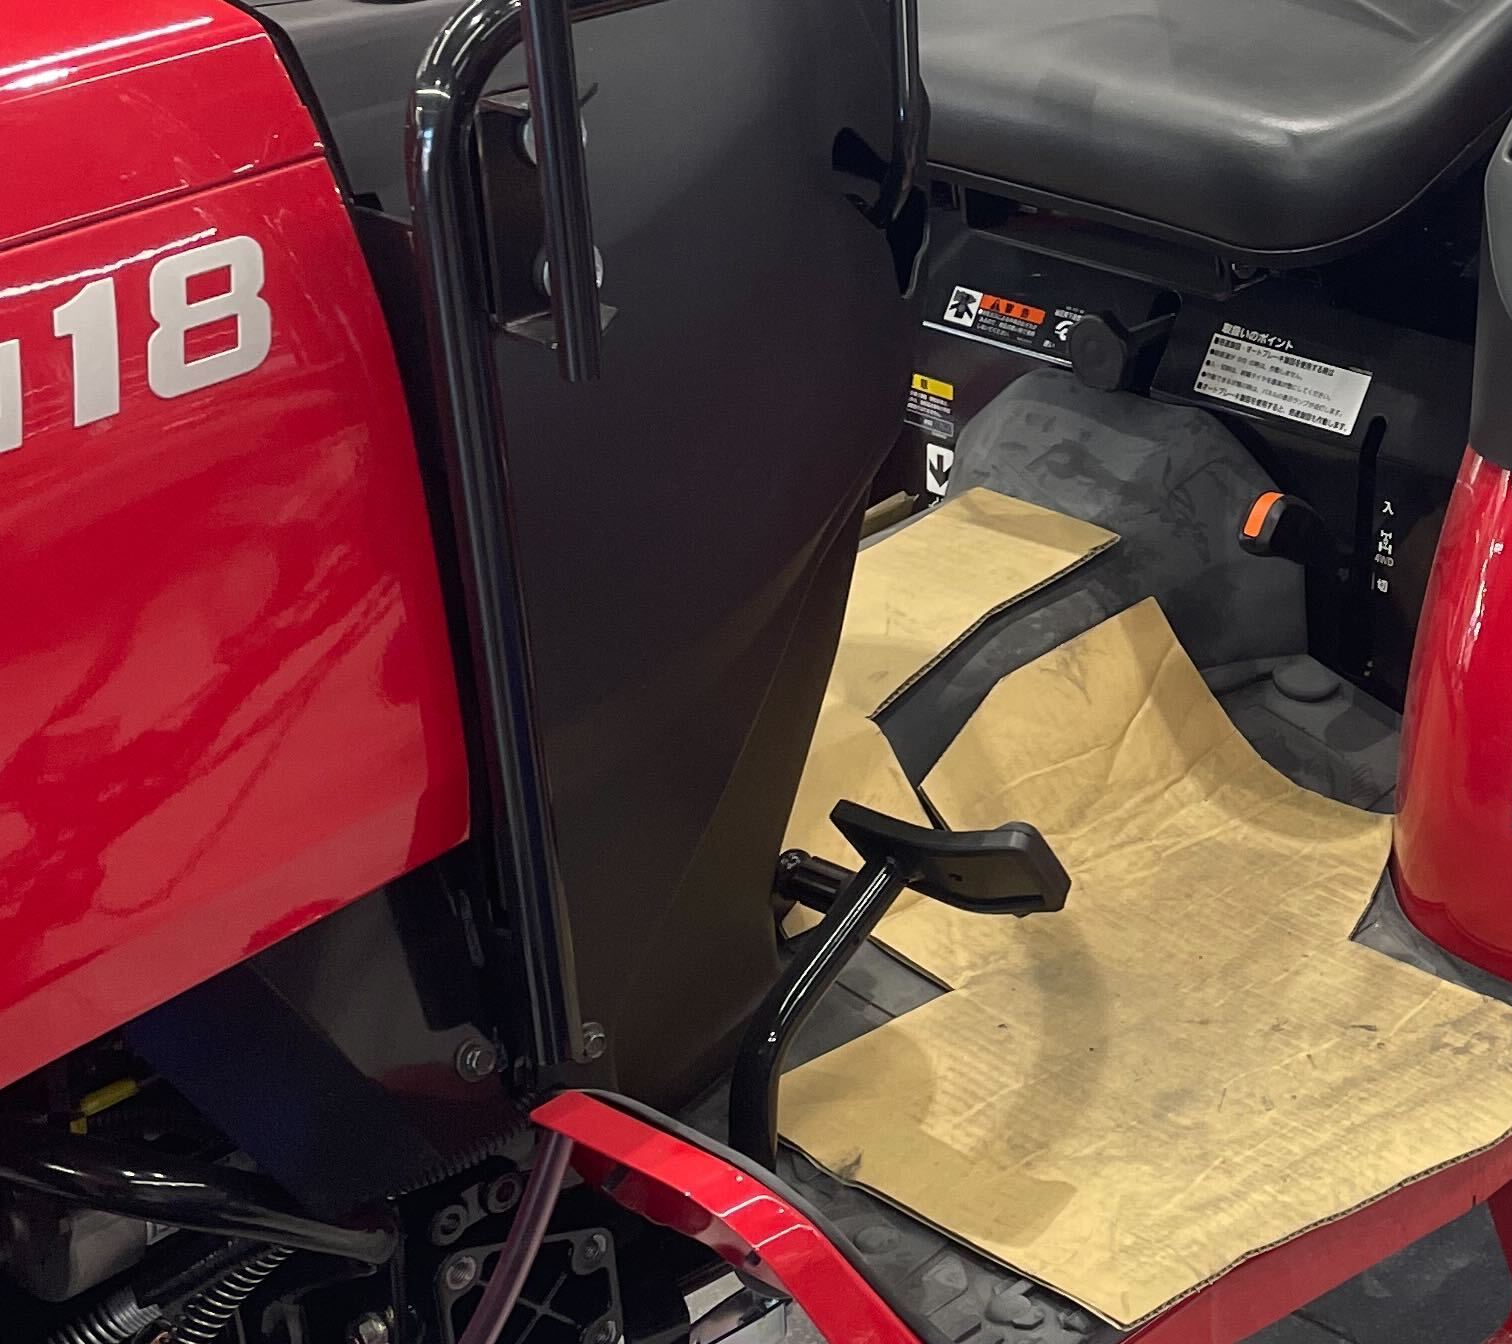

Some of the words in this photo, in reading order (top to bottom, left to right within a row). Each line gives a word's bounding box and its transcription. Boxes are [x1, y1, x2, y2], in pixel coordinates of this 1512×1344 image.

[0, 235, 273, 453] 18
[1221, 322, 1295, 352] 取扱いのポイント
[1382, 500, 1394, 515] 入
